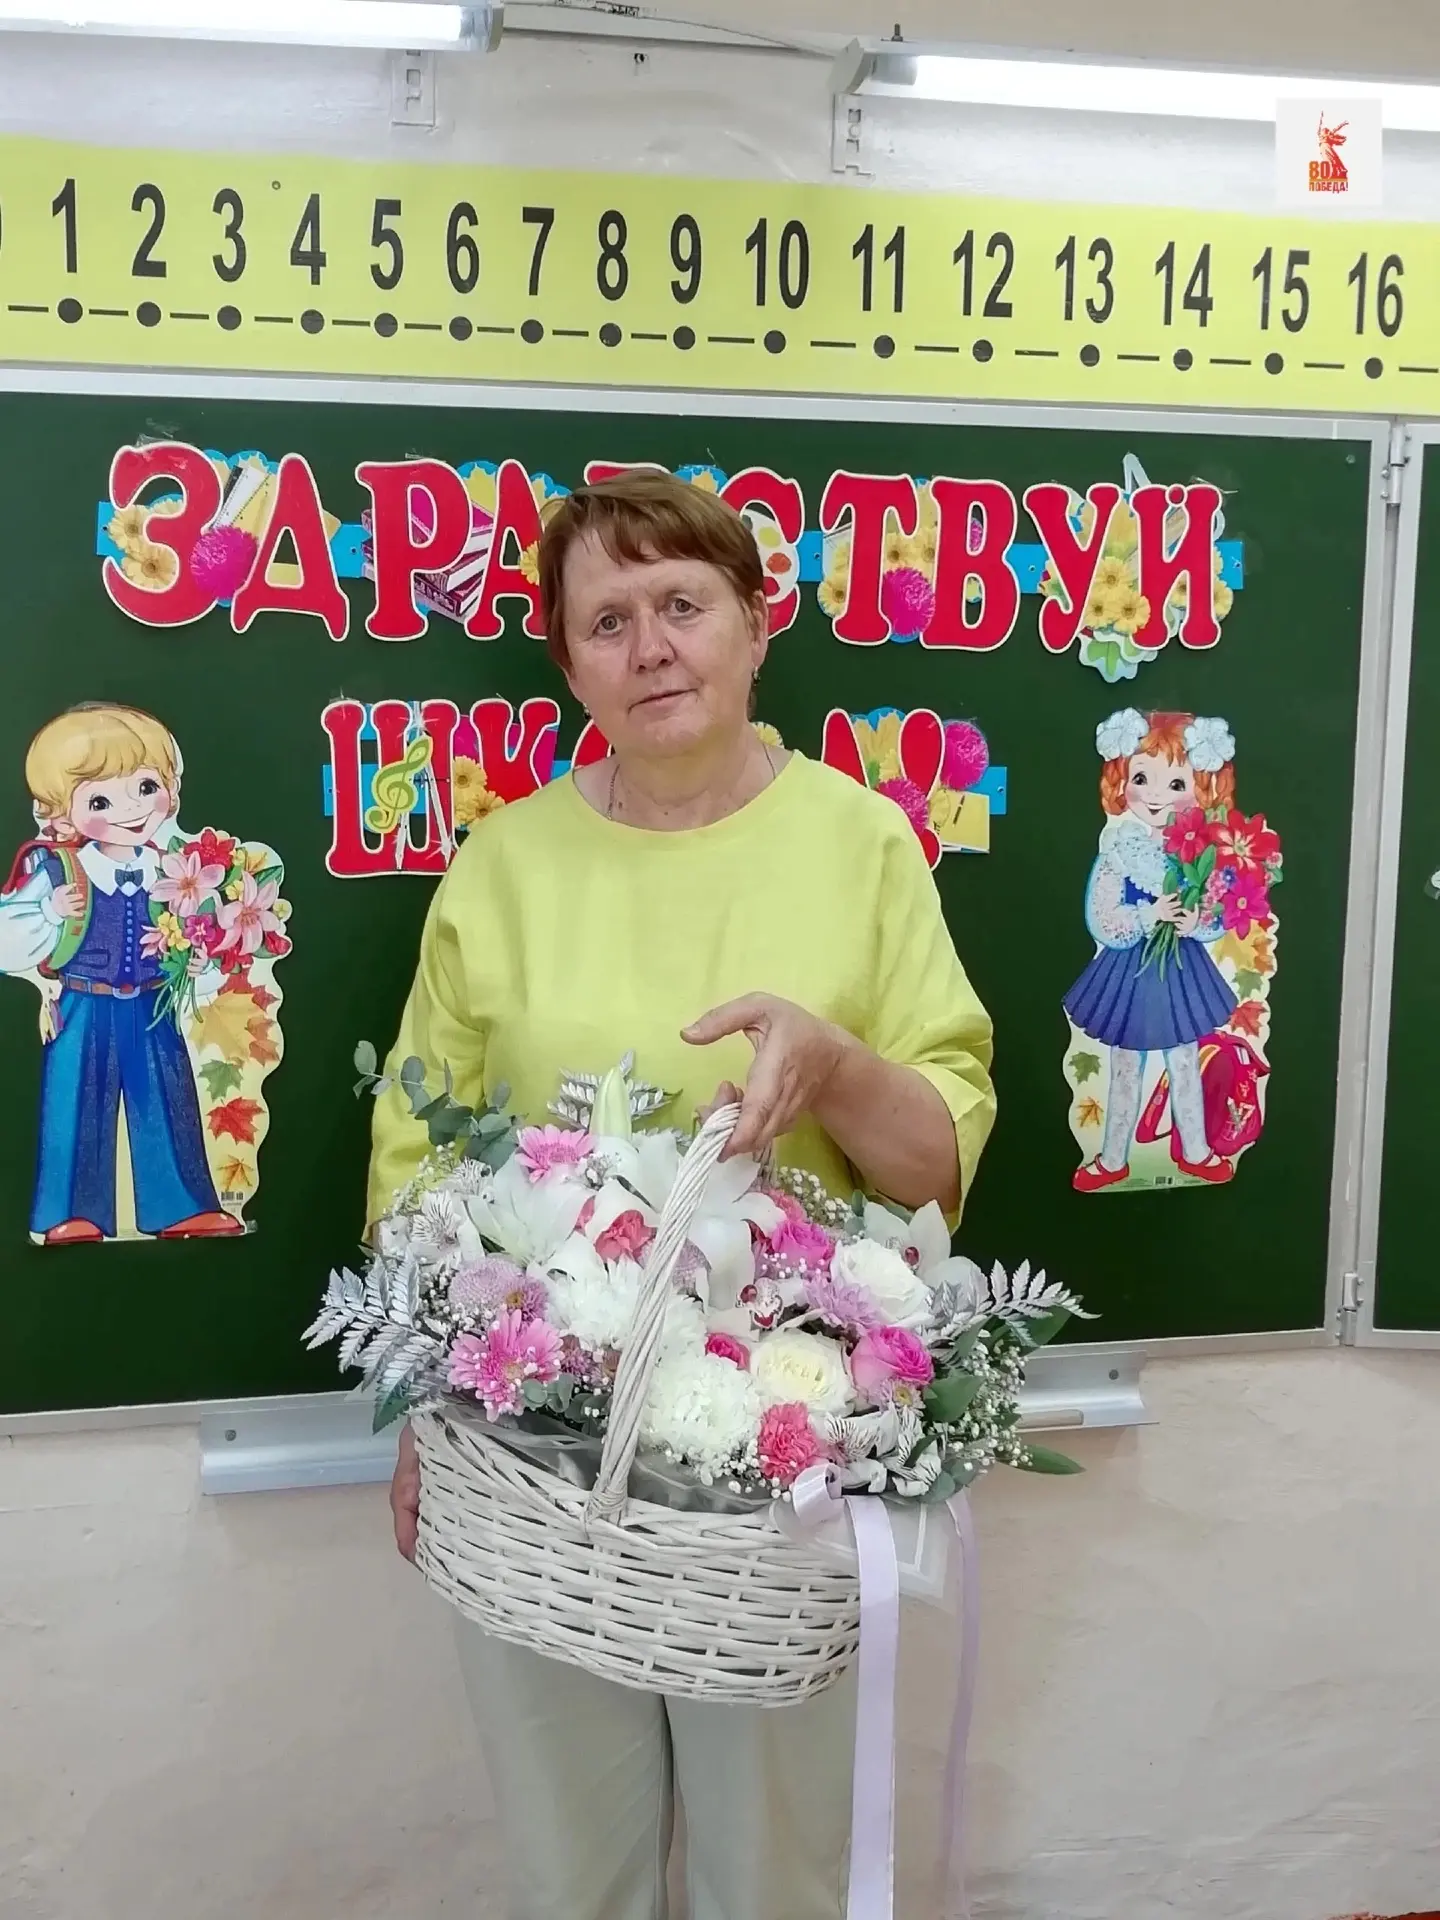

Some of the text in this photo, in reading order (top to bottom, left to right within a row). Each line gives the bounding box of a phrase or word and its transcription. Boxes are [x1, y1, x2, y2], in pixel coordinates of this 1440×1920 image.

[53, 179, 77, 273] 1
[132, 184, 167, 278] 2
[213, 189, 247, 283] 3
[290, 194, 327, 286] 4
[371, 199, 404, 291] 5
[446, 202, 480, 294] 6
[522, 207, 555, 296] 7
[597, 210, 629, 302] 8
[670, 214, 702, 304] 9
[745, 218, 810, 309] 10
[853, 224, 905, 313] 11
[953, 230, 1014, 318] 12
[1055, 236, 1114, 323] 13
[1155, 241, 1213, 328] 14
[1252, 247, 1310, 333] 15
[1348, 252, 1405, 338] 16
[103, 441, 1223, 653] ЗДРАСТВУЙ
